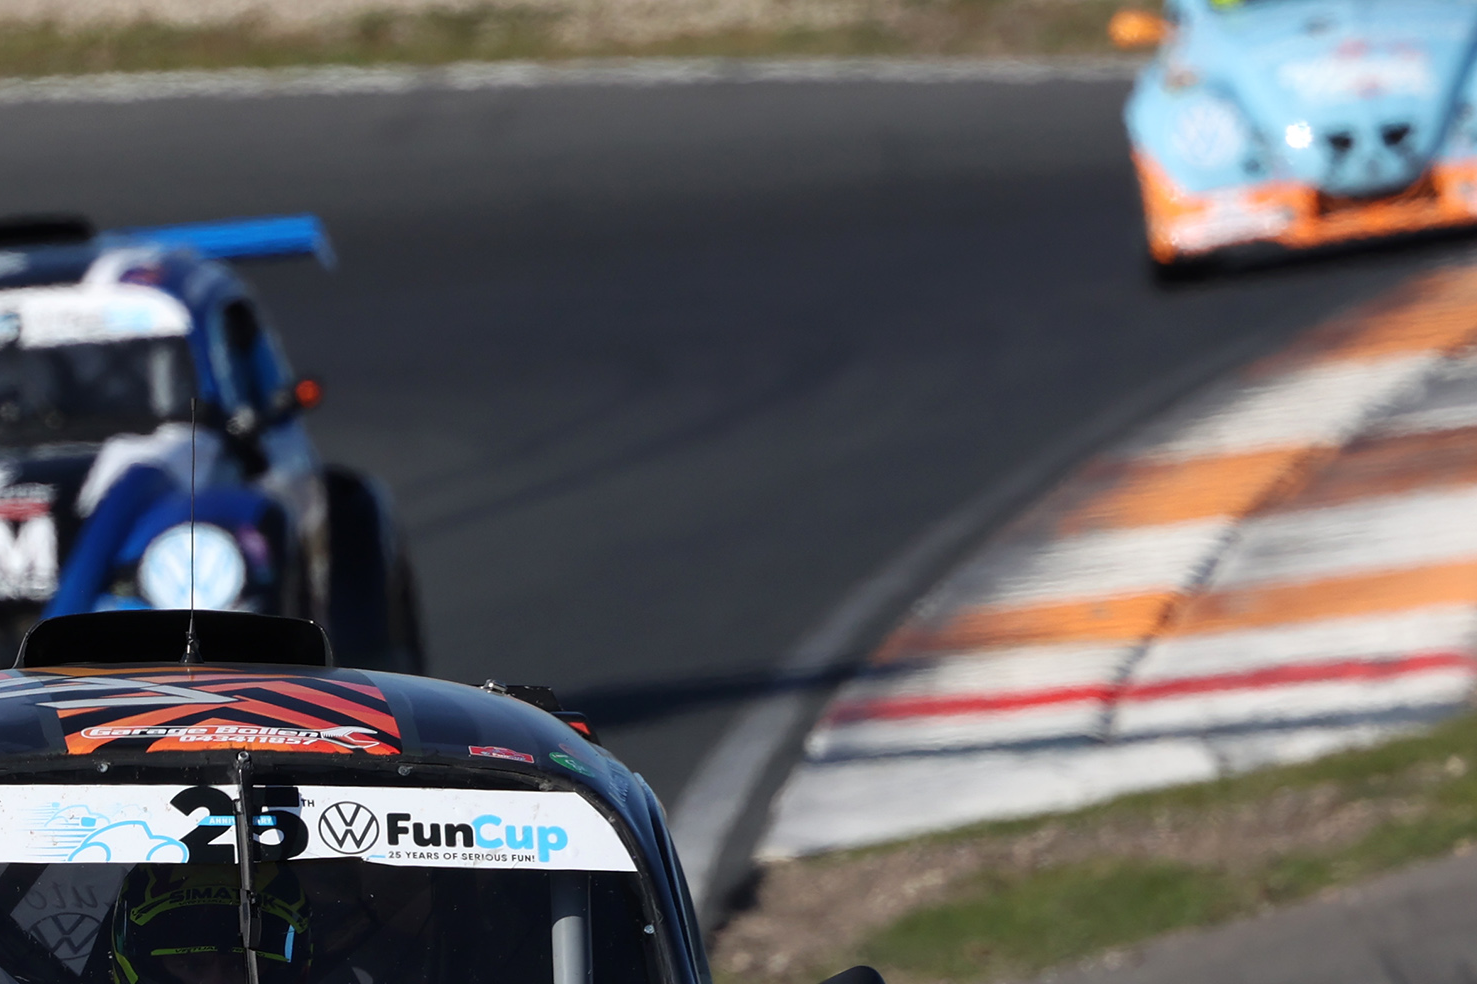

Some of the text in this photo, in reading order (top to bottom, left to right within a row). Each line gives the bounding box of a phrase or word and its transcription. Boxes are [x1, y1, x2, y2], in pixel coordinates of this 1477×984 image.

[90, 726, 321, 739] Garage Bollen
[179, 735, 318, 747] 043411857
[170, 786, 310, 862] 25
[318, 801, 380, 855] VW
[387, 812, 568, 862] FunCup
[387, 850, 535, 863] 25 YEARS OF SERIOUS FUN!
